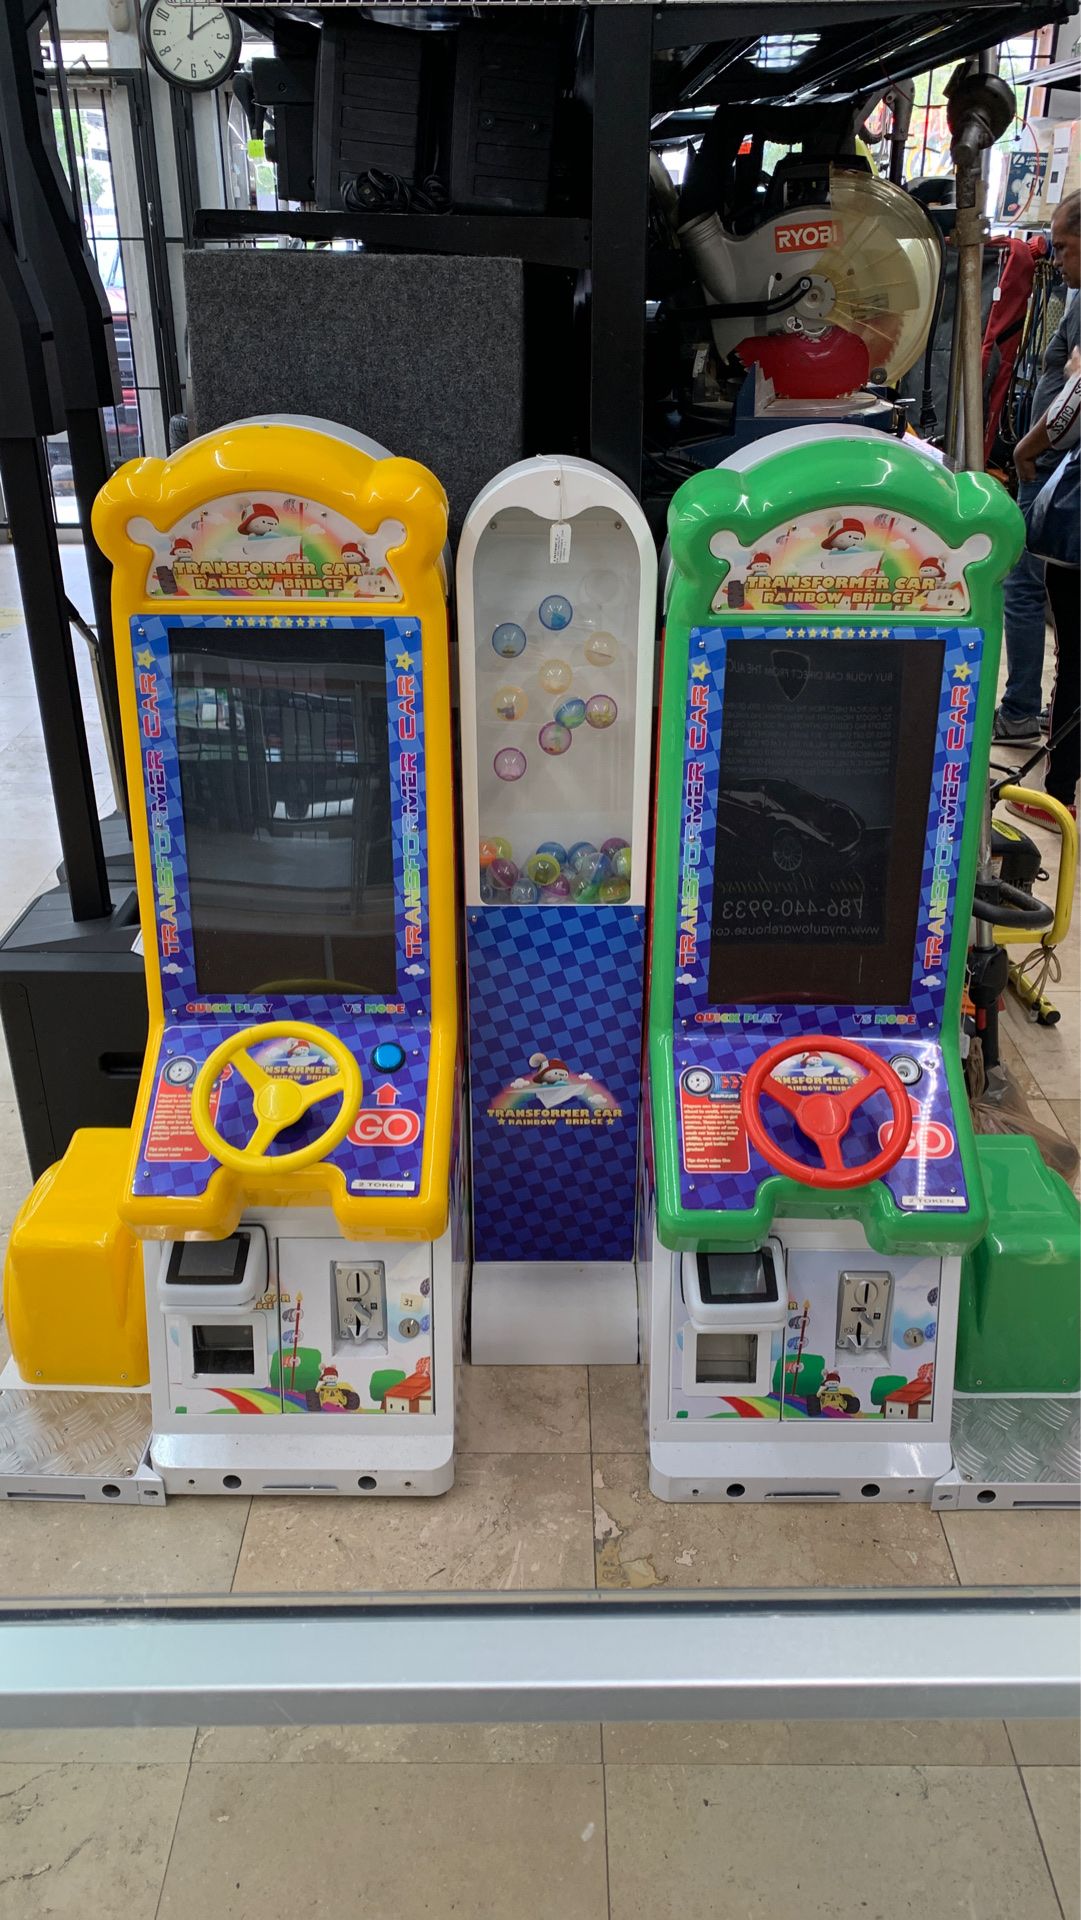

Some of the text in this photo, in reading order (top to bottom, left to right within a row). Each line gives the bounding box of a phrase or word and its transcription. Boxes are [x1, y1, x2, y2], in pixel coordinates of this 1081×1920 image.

[776, 224, 838, 249] RYOBI
[1052, 404, 1075, 435] GUESS
[173, 561, 364, 577] TRANSFORMER CAR
[193, 577, 276, 590] RAINBOW
[746, 575, 937, 591] TRANSFORMER CAR
[762, 591, 844, 604] RAINBOW
[140, 672, 179, 957] TRANSFORMER CAR
[396, 674, 423, 958] TRANSFORMER CAR
[679, 684, 710, 968] TRANSFORMER CAR
[923, 684, 969, 969] TRANSFORMER CAR
[186, 1003, 273, 1014] QUICK PLAY
[342, 1004, 405, 1014] VS MODE
[695, 1013, 782, 1024] QUICK PLAY
[853, 1014, 917, 1025] VS MODE
[264, 1066, 331, 1075] NSFORMER
[487, 1108, 623, 1118] TRANSFORMER CAR
[355, 1113, 413, 1140] GO
[508, 1118, 557, 1126] RAINBOW
[403, 1298, 413, 1307] 31
